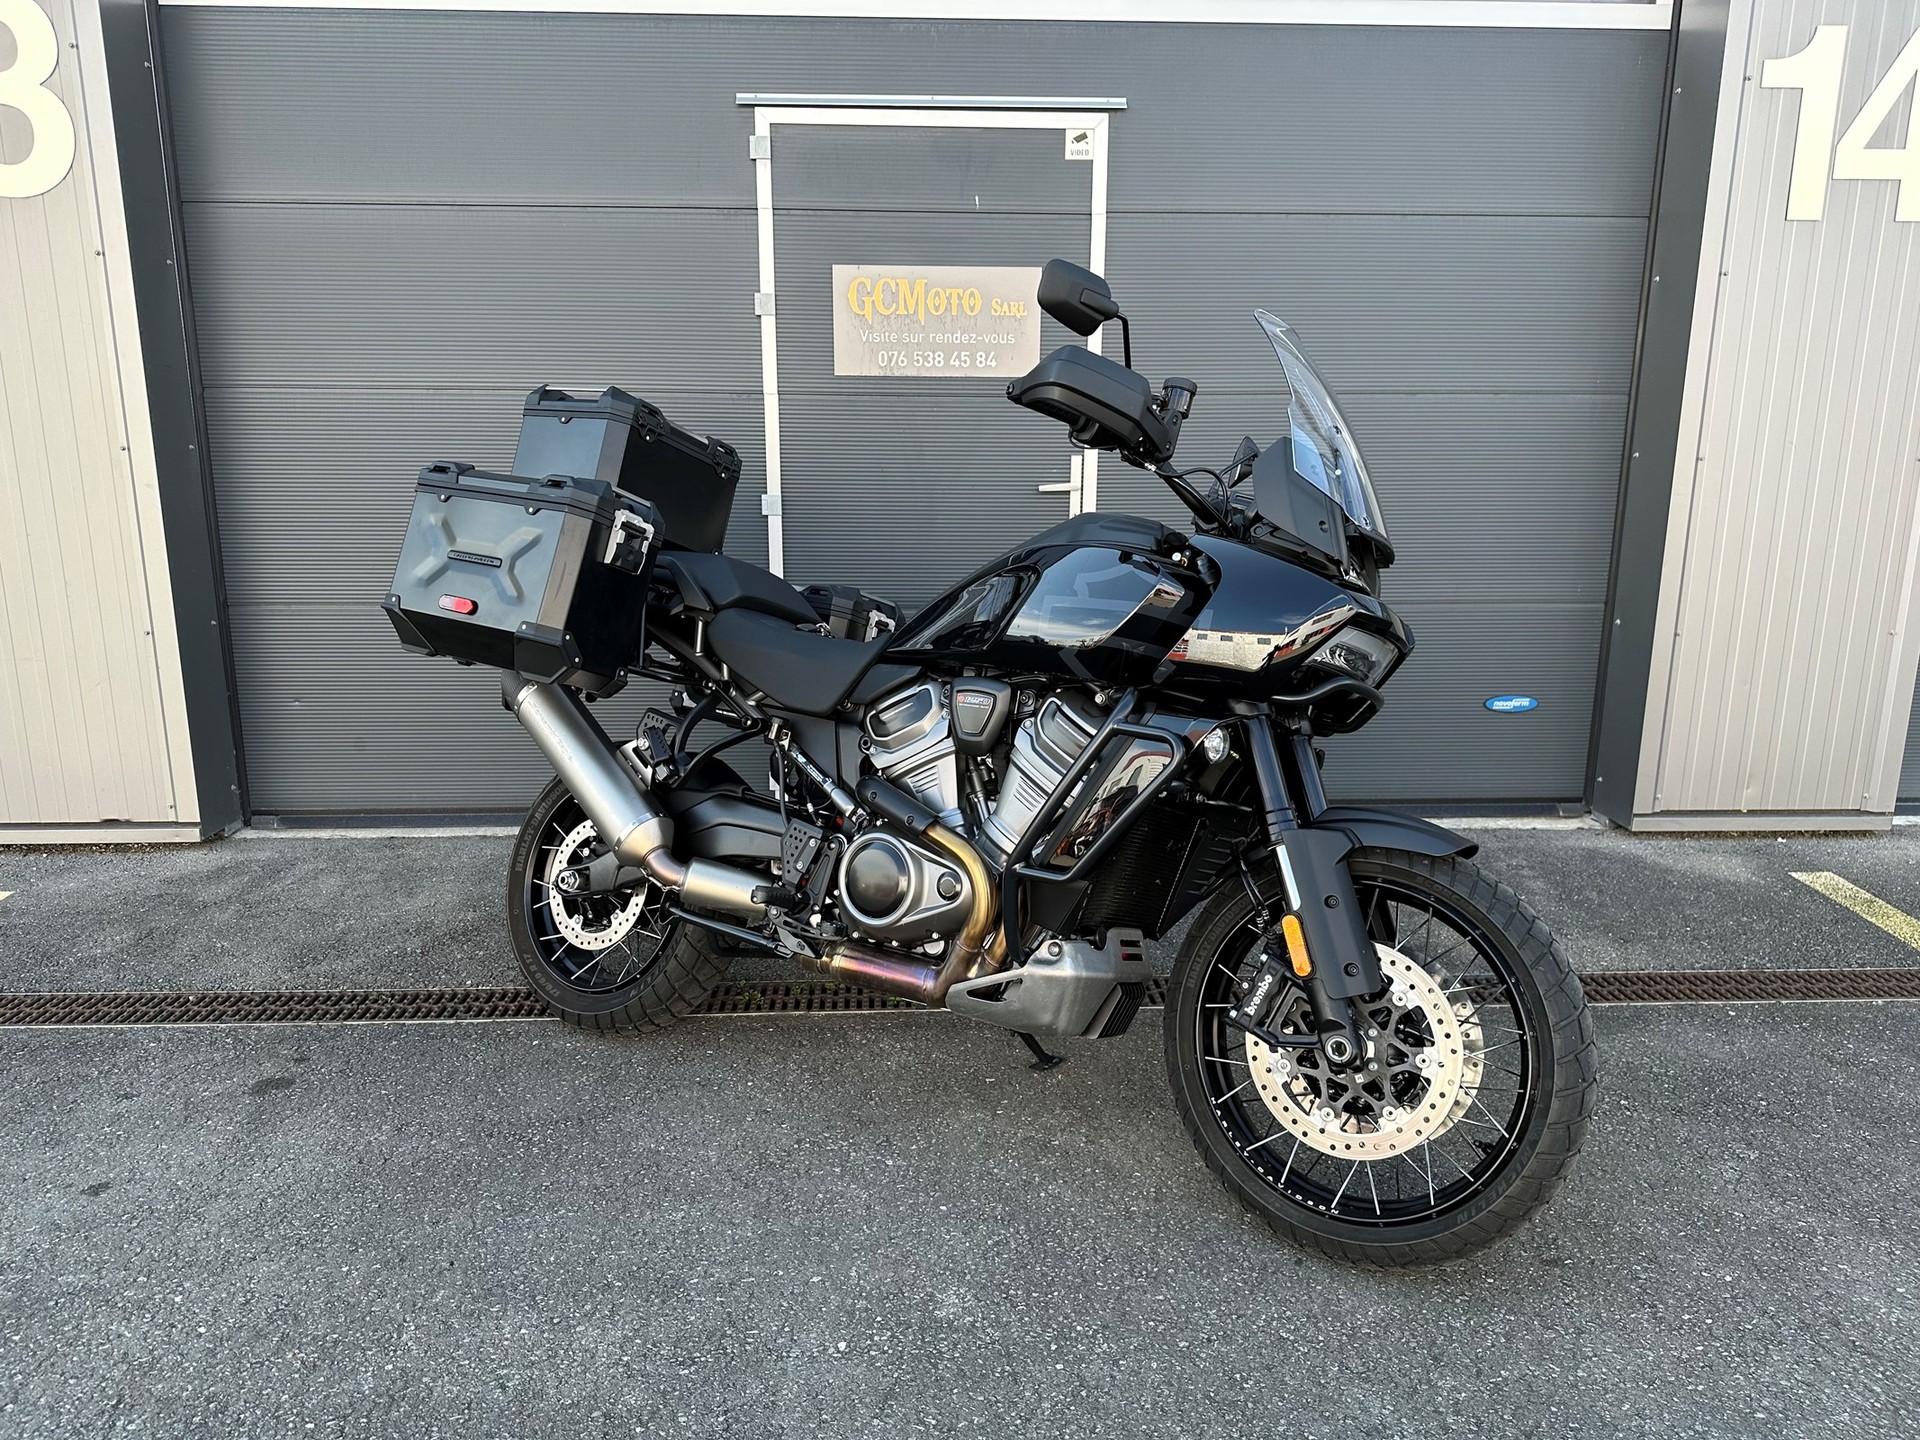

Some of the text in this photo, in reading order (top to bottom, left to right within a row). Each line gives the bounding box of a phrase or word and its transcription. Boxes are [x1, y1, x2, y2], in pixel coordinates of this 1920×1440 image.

[1760, 25, 1920, 222] 14
[860, 329, 1015, 344] Visite sur rendez-vous
[878, 351, 997, 368] 076 538 45 84
[1243, 974, 1273, 1016] brembo
[1210, 1096, 1340, 1215] HARLEY-DAVIDSON
[1456, 1145, 1533, 1225] MICHELIN
